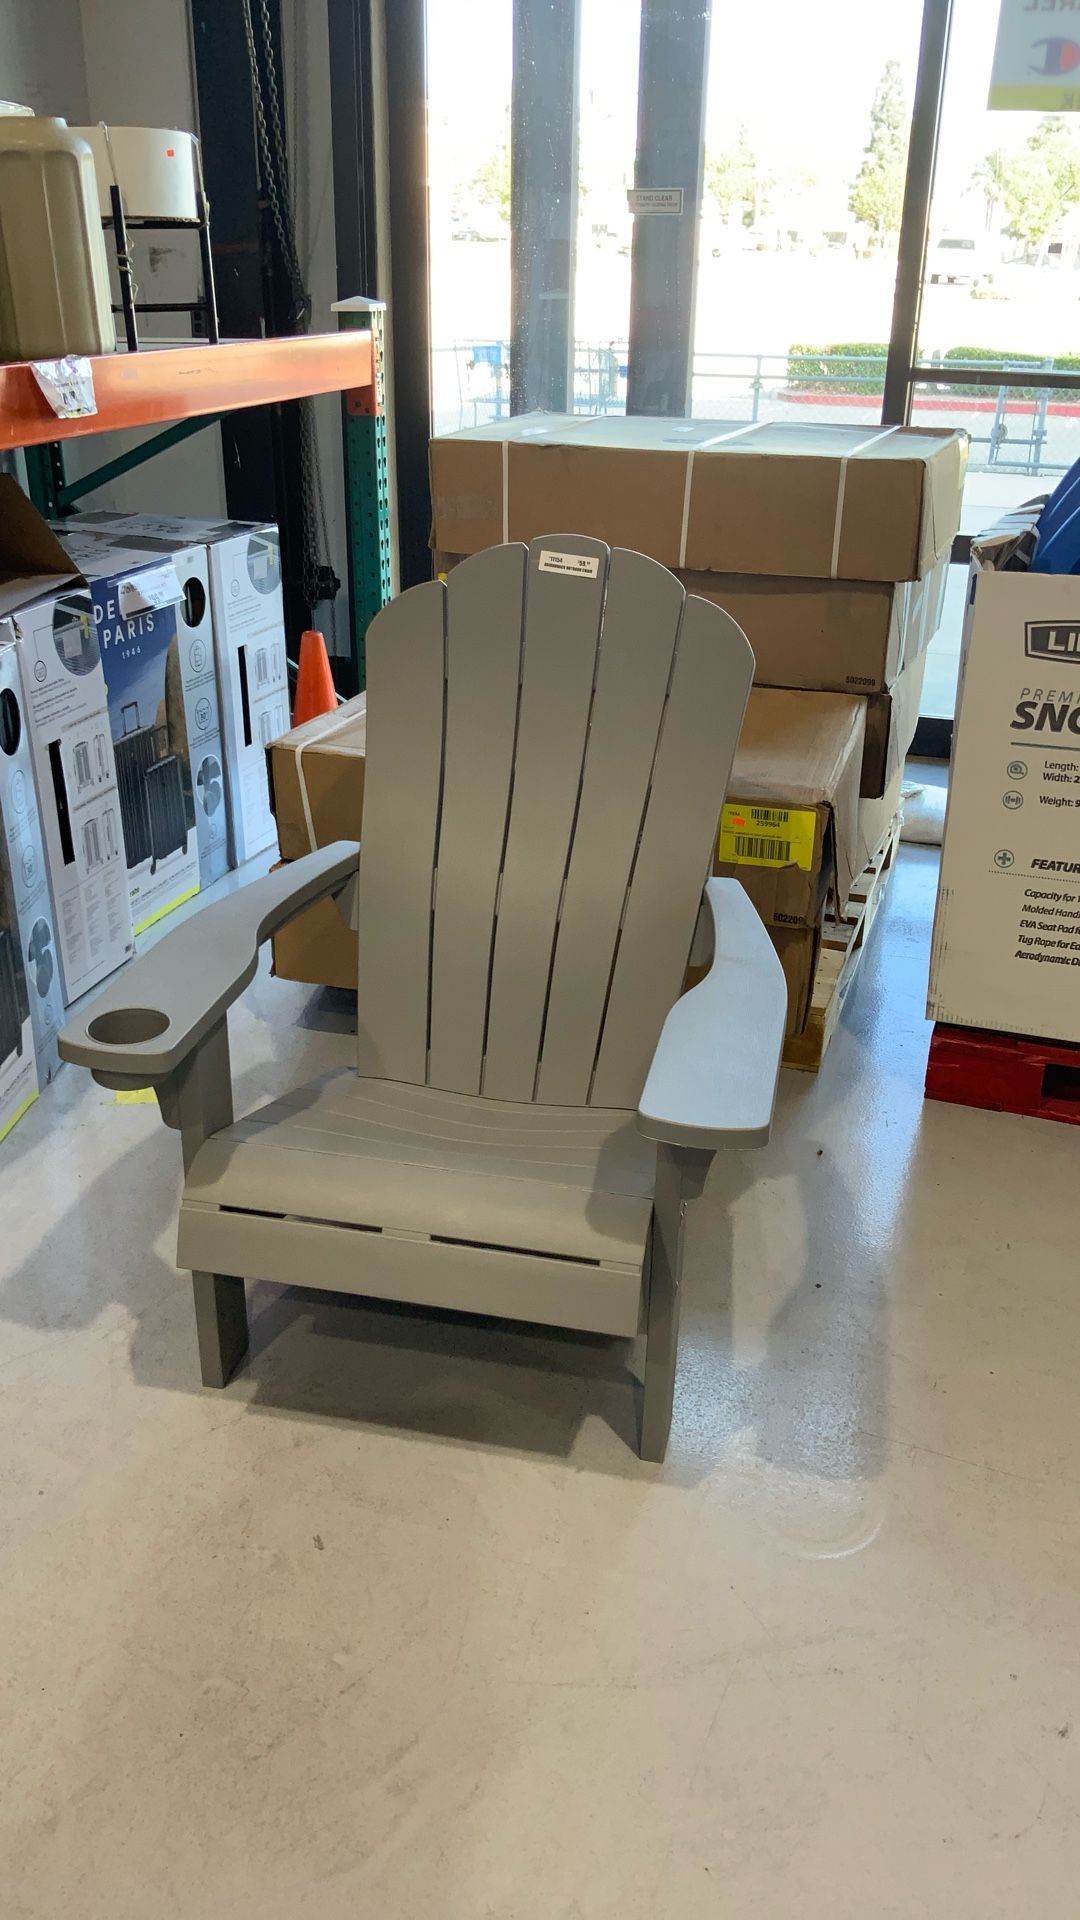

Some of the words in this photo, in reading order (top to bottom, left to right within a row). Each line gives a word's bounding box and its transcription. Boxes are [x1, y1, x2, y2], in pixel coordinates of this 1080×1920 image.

[93, 600, 116, 625] DE
[103, 613, 155, 649] PARIS
[121, 645, 141, 660] 1946
[1044, 760, 1079, 773] Length:
[1042, 772, 1073, 784] Width:
[1039, 795, 1074, 808] Weight:
[1024, 888, 1062, 902] Capacity
[1062, 893, 1076, 902] for
[1021, 904, 1055, 916] Molded
[1019, 919, 1037, 929] EVA
[1037, 922, 1057, 932] Seat
[1057, 924, 1075, 934] Pad
[1018, 934, 1034, 945] Tug
[1034, 937, 1056, 948] Rope
[1056, 940, 1070, 949] for
[1014, 950, 1071, 965] Aerodynamic
